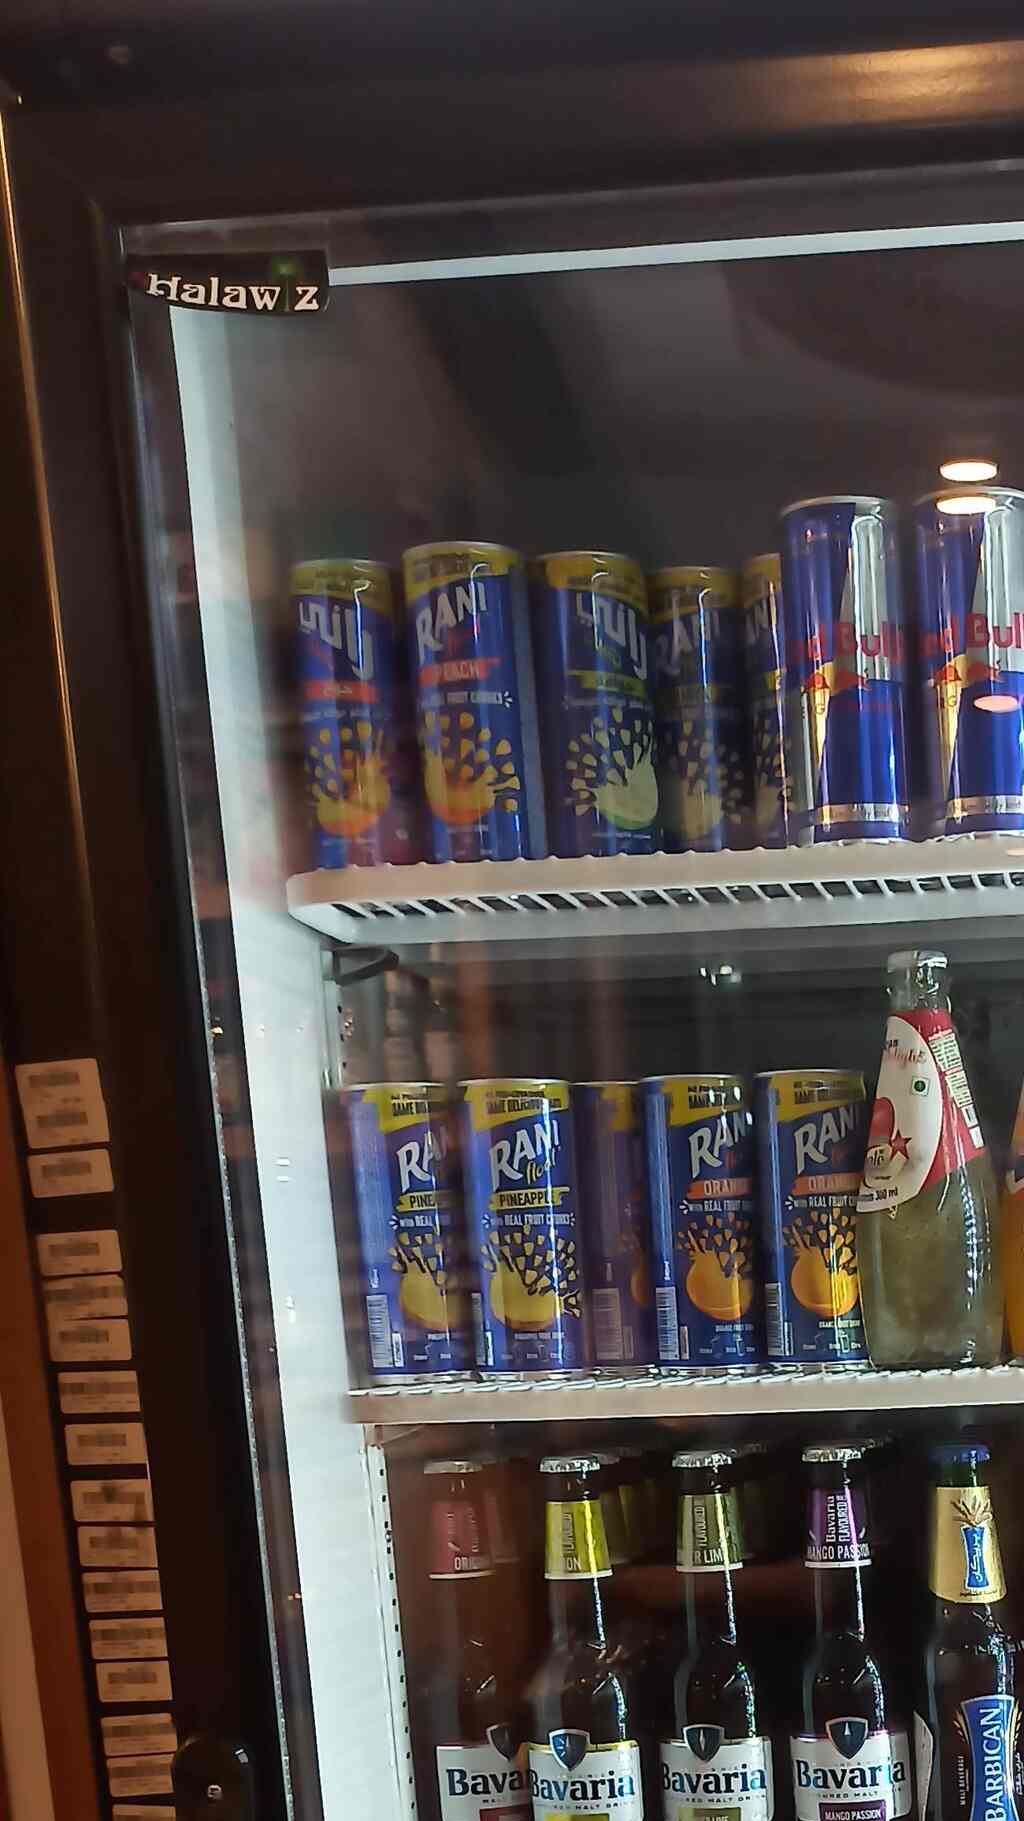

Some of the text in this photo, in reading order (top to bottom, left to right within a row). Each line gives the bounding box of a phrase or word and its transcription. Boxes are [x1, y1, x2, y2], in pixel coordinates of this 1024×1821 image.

[415, 581, 488, 666] RANI
[489, 1119, 560, 1193] RANI
[689, 1111, 749, 1179] RAN
[528, 1769, 636, 1801] Bavaria
[662, 1761, 767, 1795] Bavaria
[796, 1755, 906, 1790] Bavaria
[824, 1808, 882, 1821] MANGO PASSION
